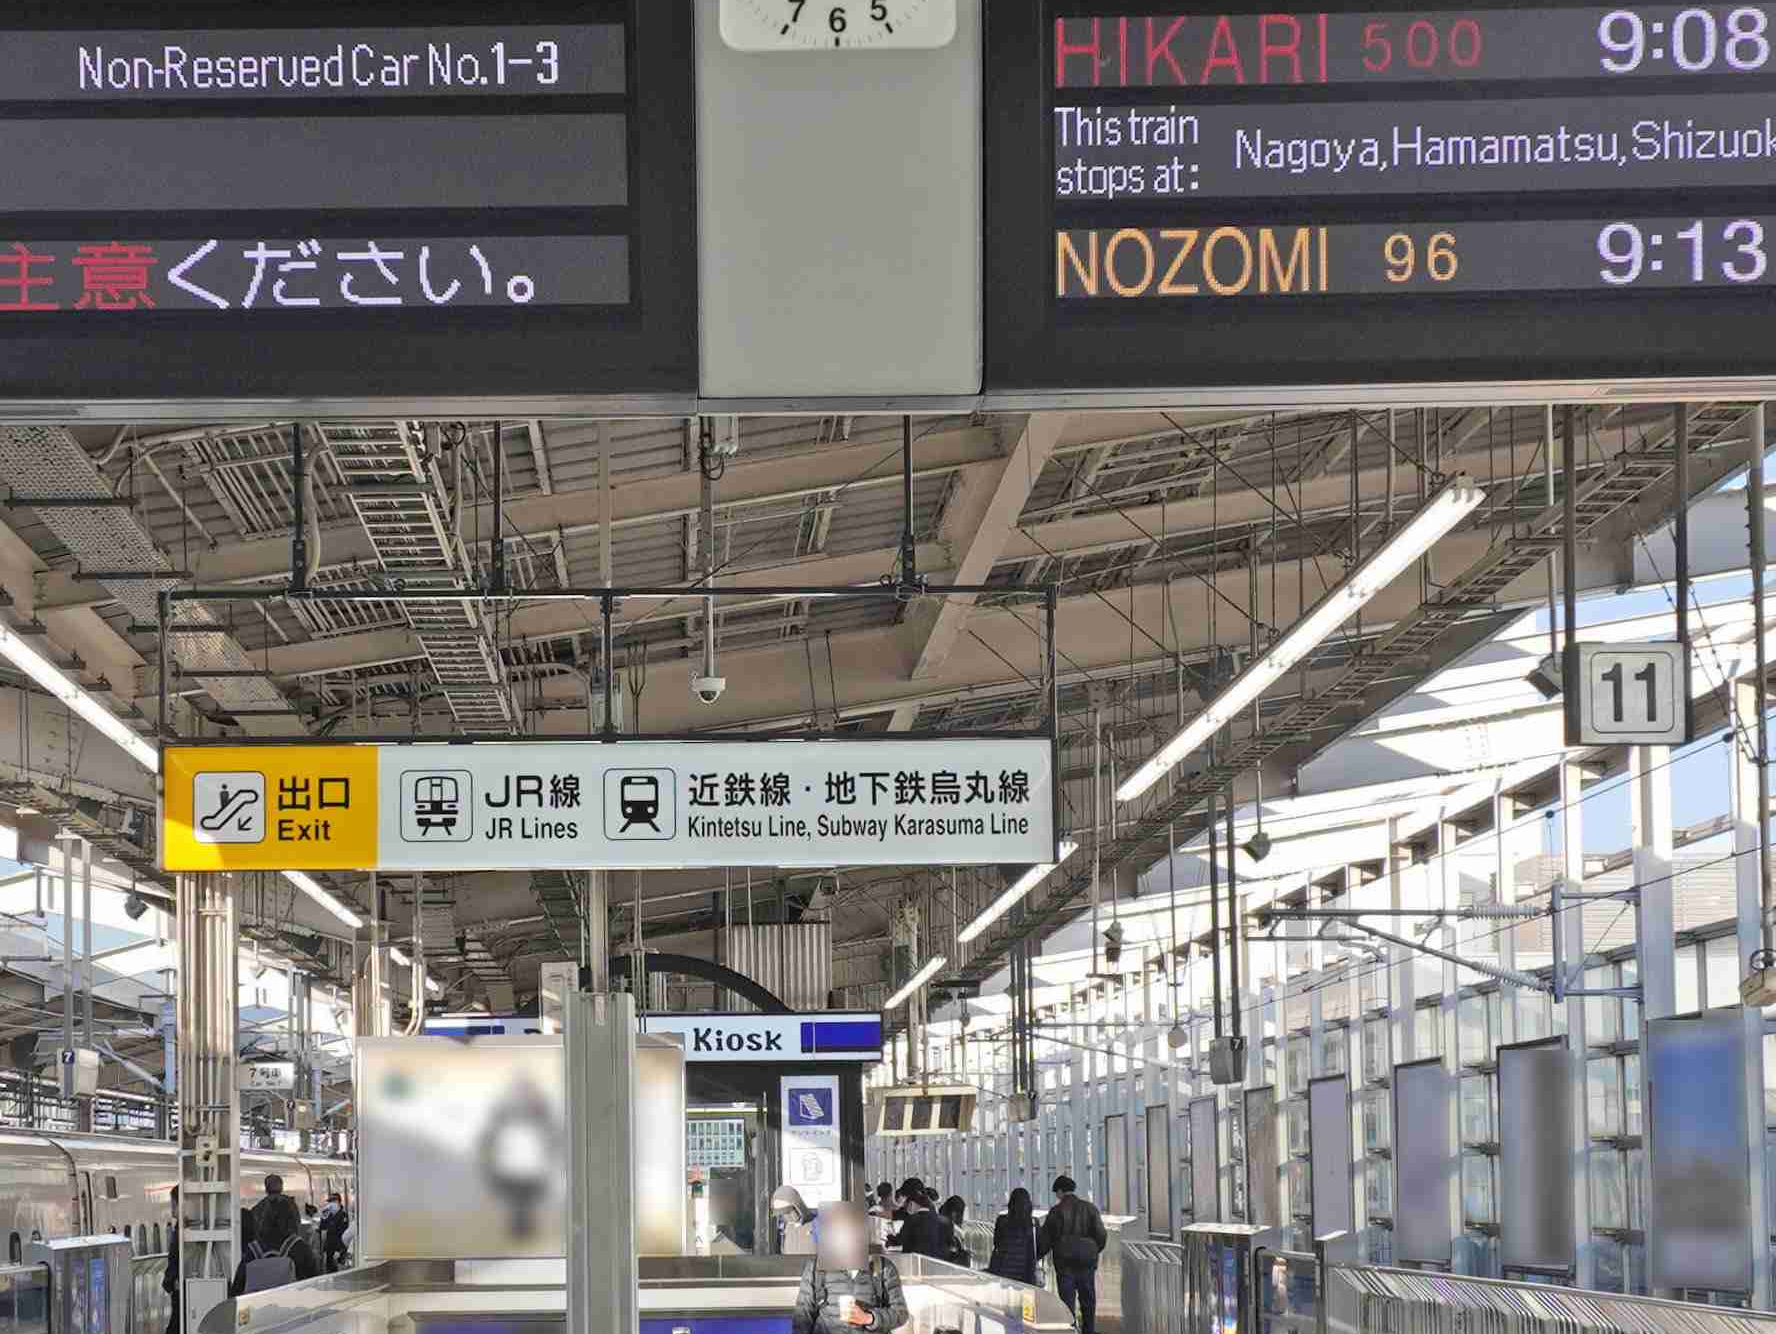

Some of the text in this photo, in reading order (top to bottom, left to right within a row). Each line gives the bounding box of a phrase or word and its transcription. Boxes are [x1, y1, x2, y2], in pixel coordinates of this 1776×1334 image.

[829, 8, 846, 32] 6
[1055, 13, 1328, 87] HIKARI
[1362, 20, 1483, 72] 500
[1599, 6, 1770, 72] 9:08
[351, 44, 419, 88] Car
[1056, 107, 1199, 147] This train
[1056, 160, 1200, 201] stops at:
[1056, 226, 1328, 298] NOZOMI
[1384, 234, 1459, 283] 96
[1598, 220, 1768, 285] 9:13
[1602, 662, 1656, 722] 11
[278, 777, 350, 811] 出口
[485, 774, 580, 809] JR線
[689, 771, 1030, 806] 近鉄線・地下鉄烏丸線
[278, 819, 330, 841] Exit
[486, 818, 578, 839] JR Lines
[689, 814, 1028, 841] Kintetsu Line, Subway Karasuma Line
[64, 1052, 72, 1061] 7
[693, 1027, 782, 1052] Kiosk
